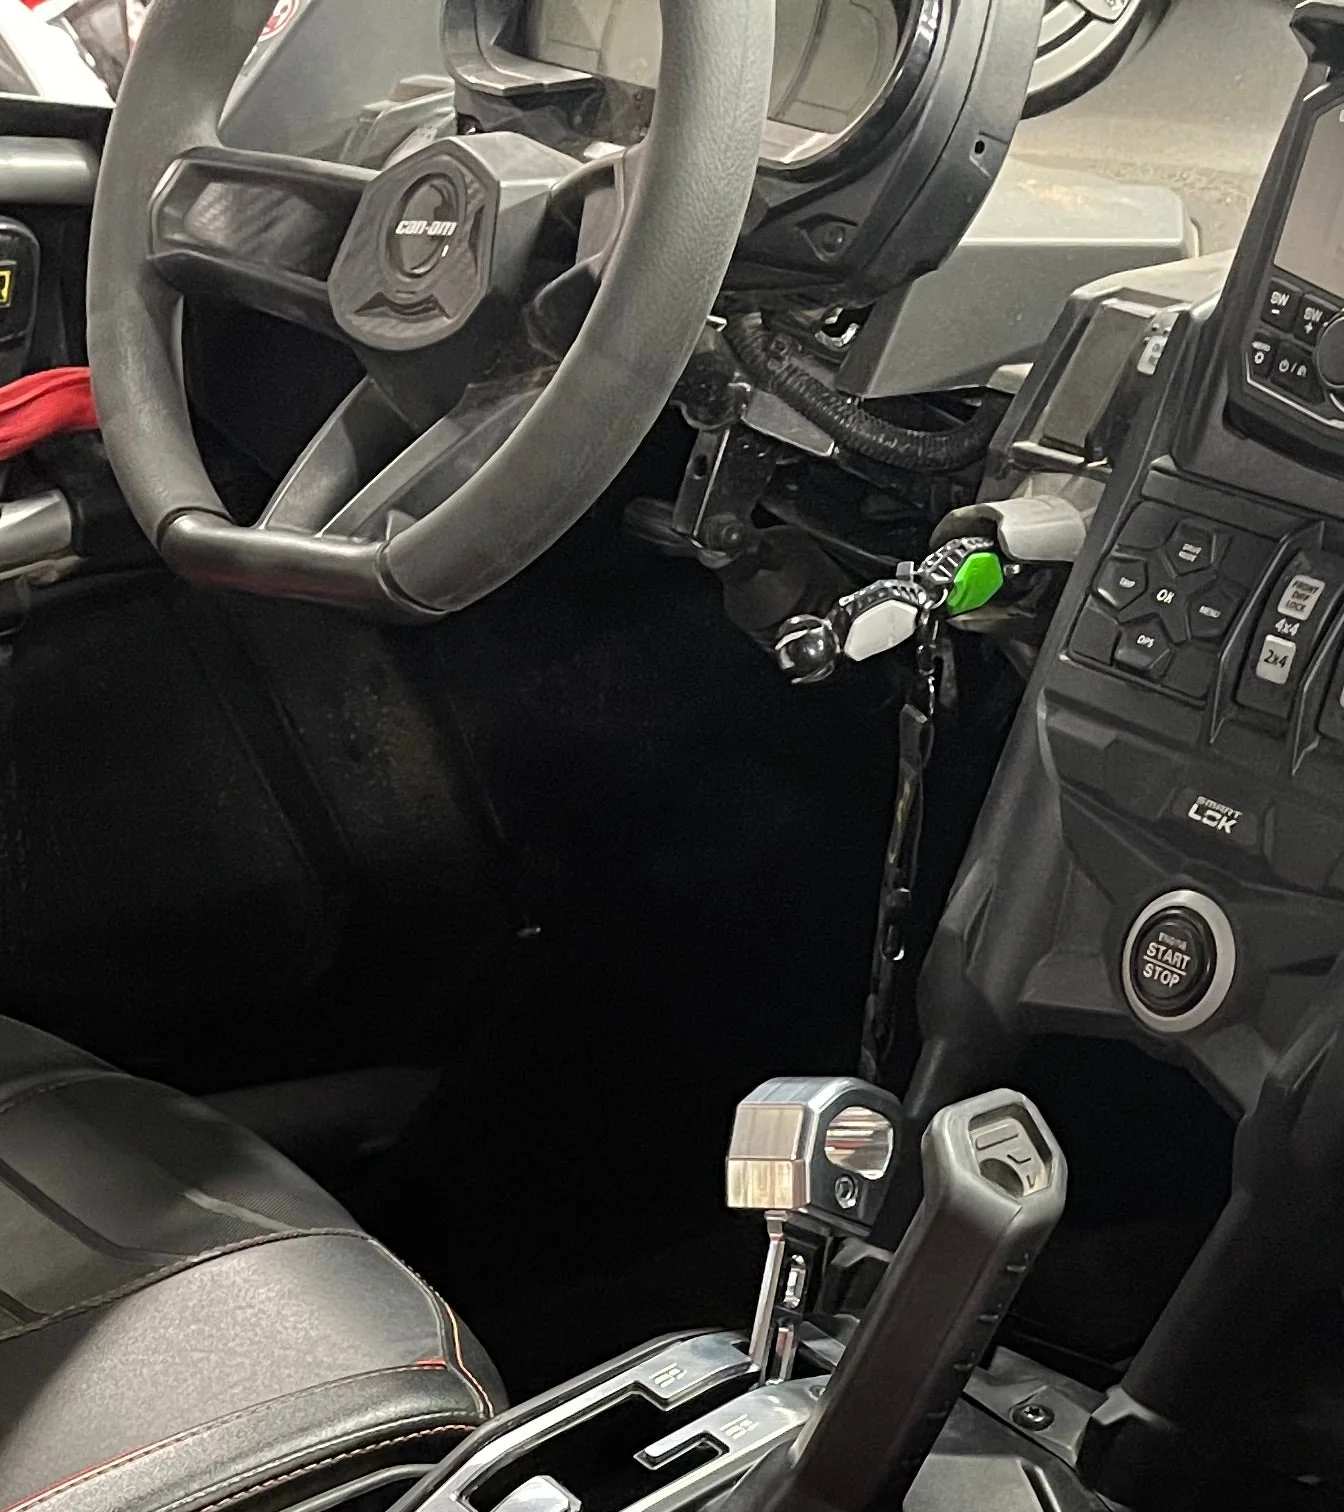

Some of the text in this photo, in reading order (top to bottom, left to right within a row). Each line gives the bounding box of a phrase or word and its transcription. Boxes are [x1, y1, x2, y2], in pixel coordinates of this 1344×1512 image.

[395, 220, 458, 236] can-am
[1156, 589, 1175, 604] OK
[1292, 581, 1321, 595] FRONT
[1285, 601, 1307, 613] LOCK
[1275, 618, 1300, 636] 4x4
[1263, 649, 1289, 668] 2x4
[1146, 942, 1191, 970] START
[1143, 963, 1180, 988] STOP
